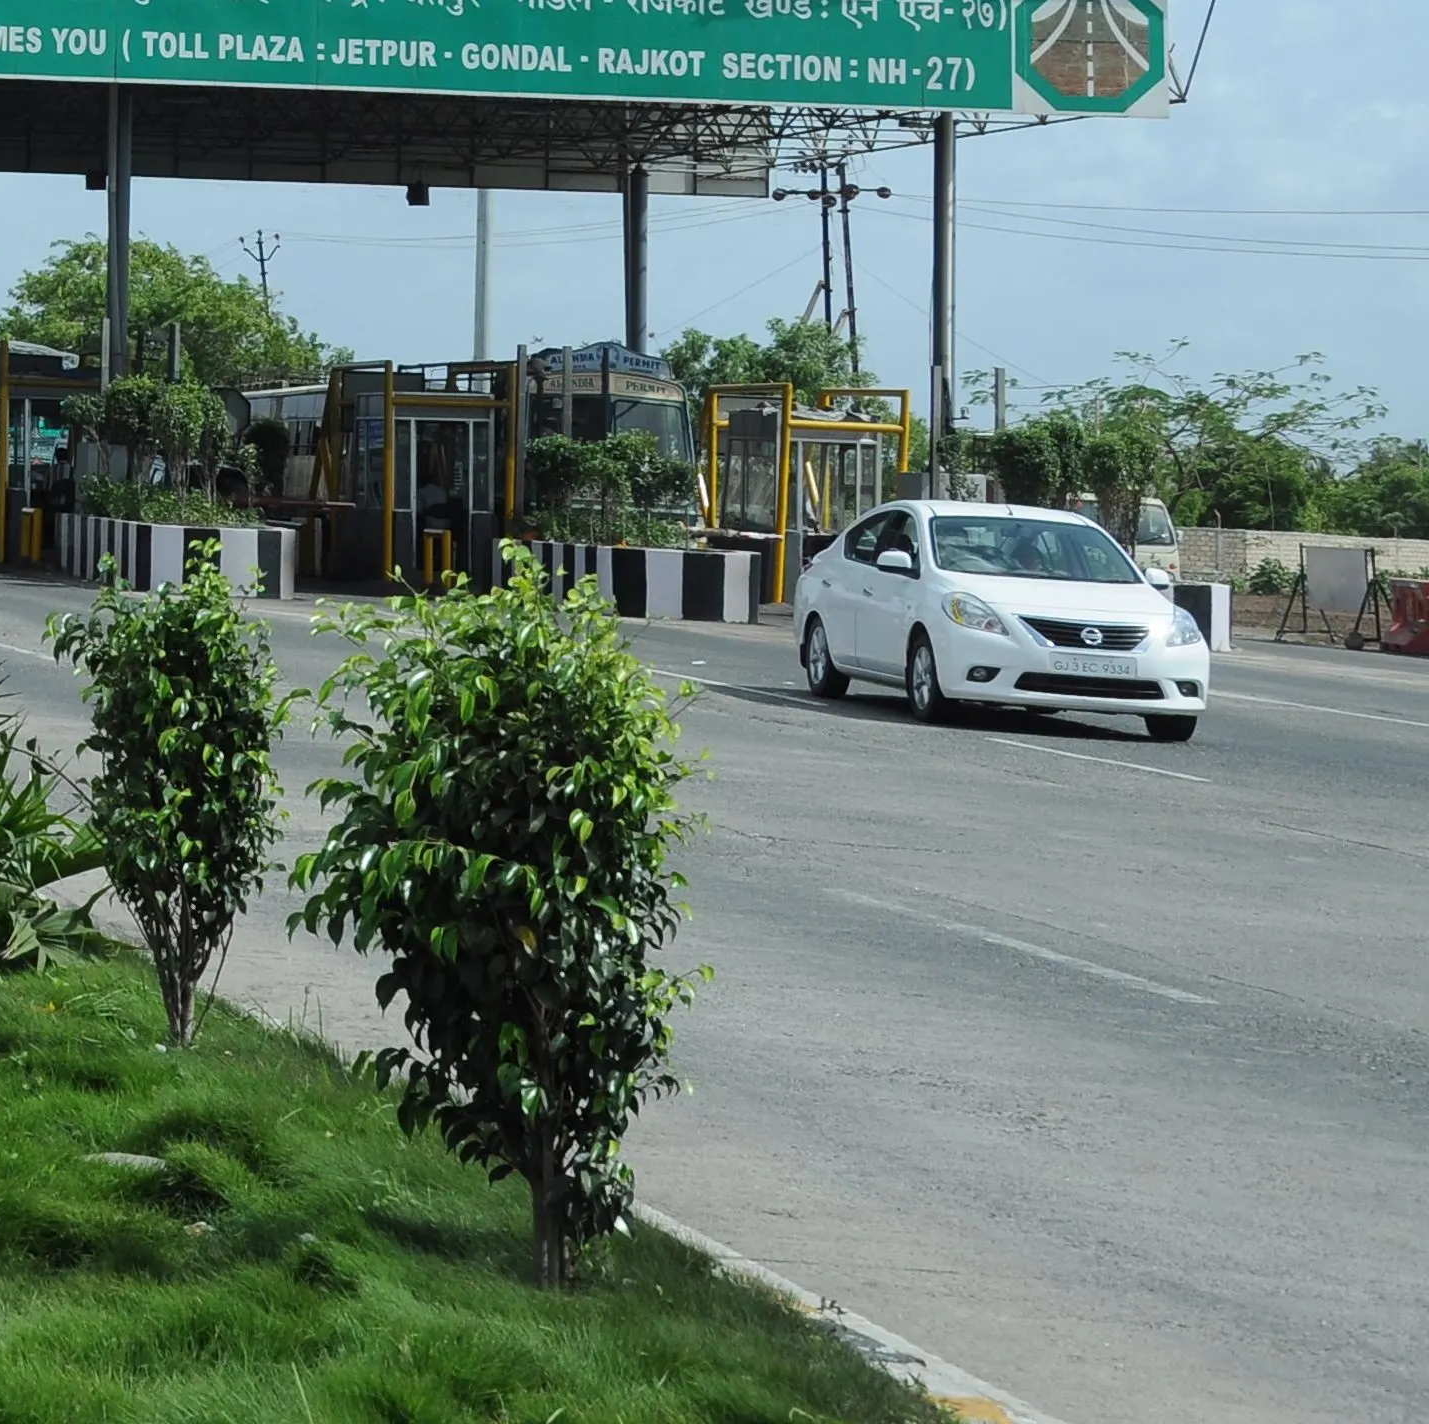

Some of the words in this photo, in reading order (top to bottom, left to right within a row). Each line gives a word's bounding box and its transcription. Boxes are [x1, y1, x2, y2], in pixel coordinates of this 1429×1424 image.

[52, 29, 105, 55] YOU
[219, 34, 303, 62] PLAZA
[462, 44, 571, 71] GONDAL
[599, 48, 705, 76] RAJKOT
[623, 355, 661, 370] PERMIT
[625, 380, 666, 394] PERMIT
